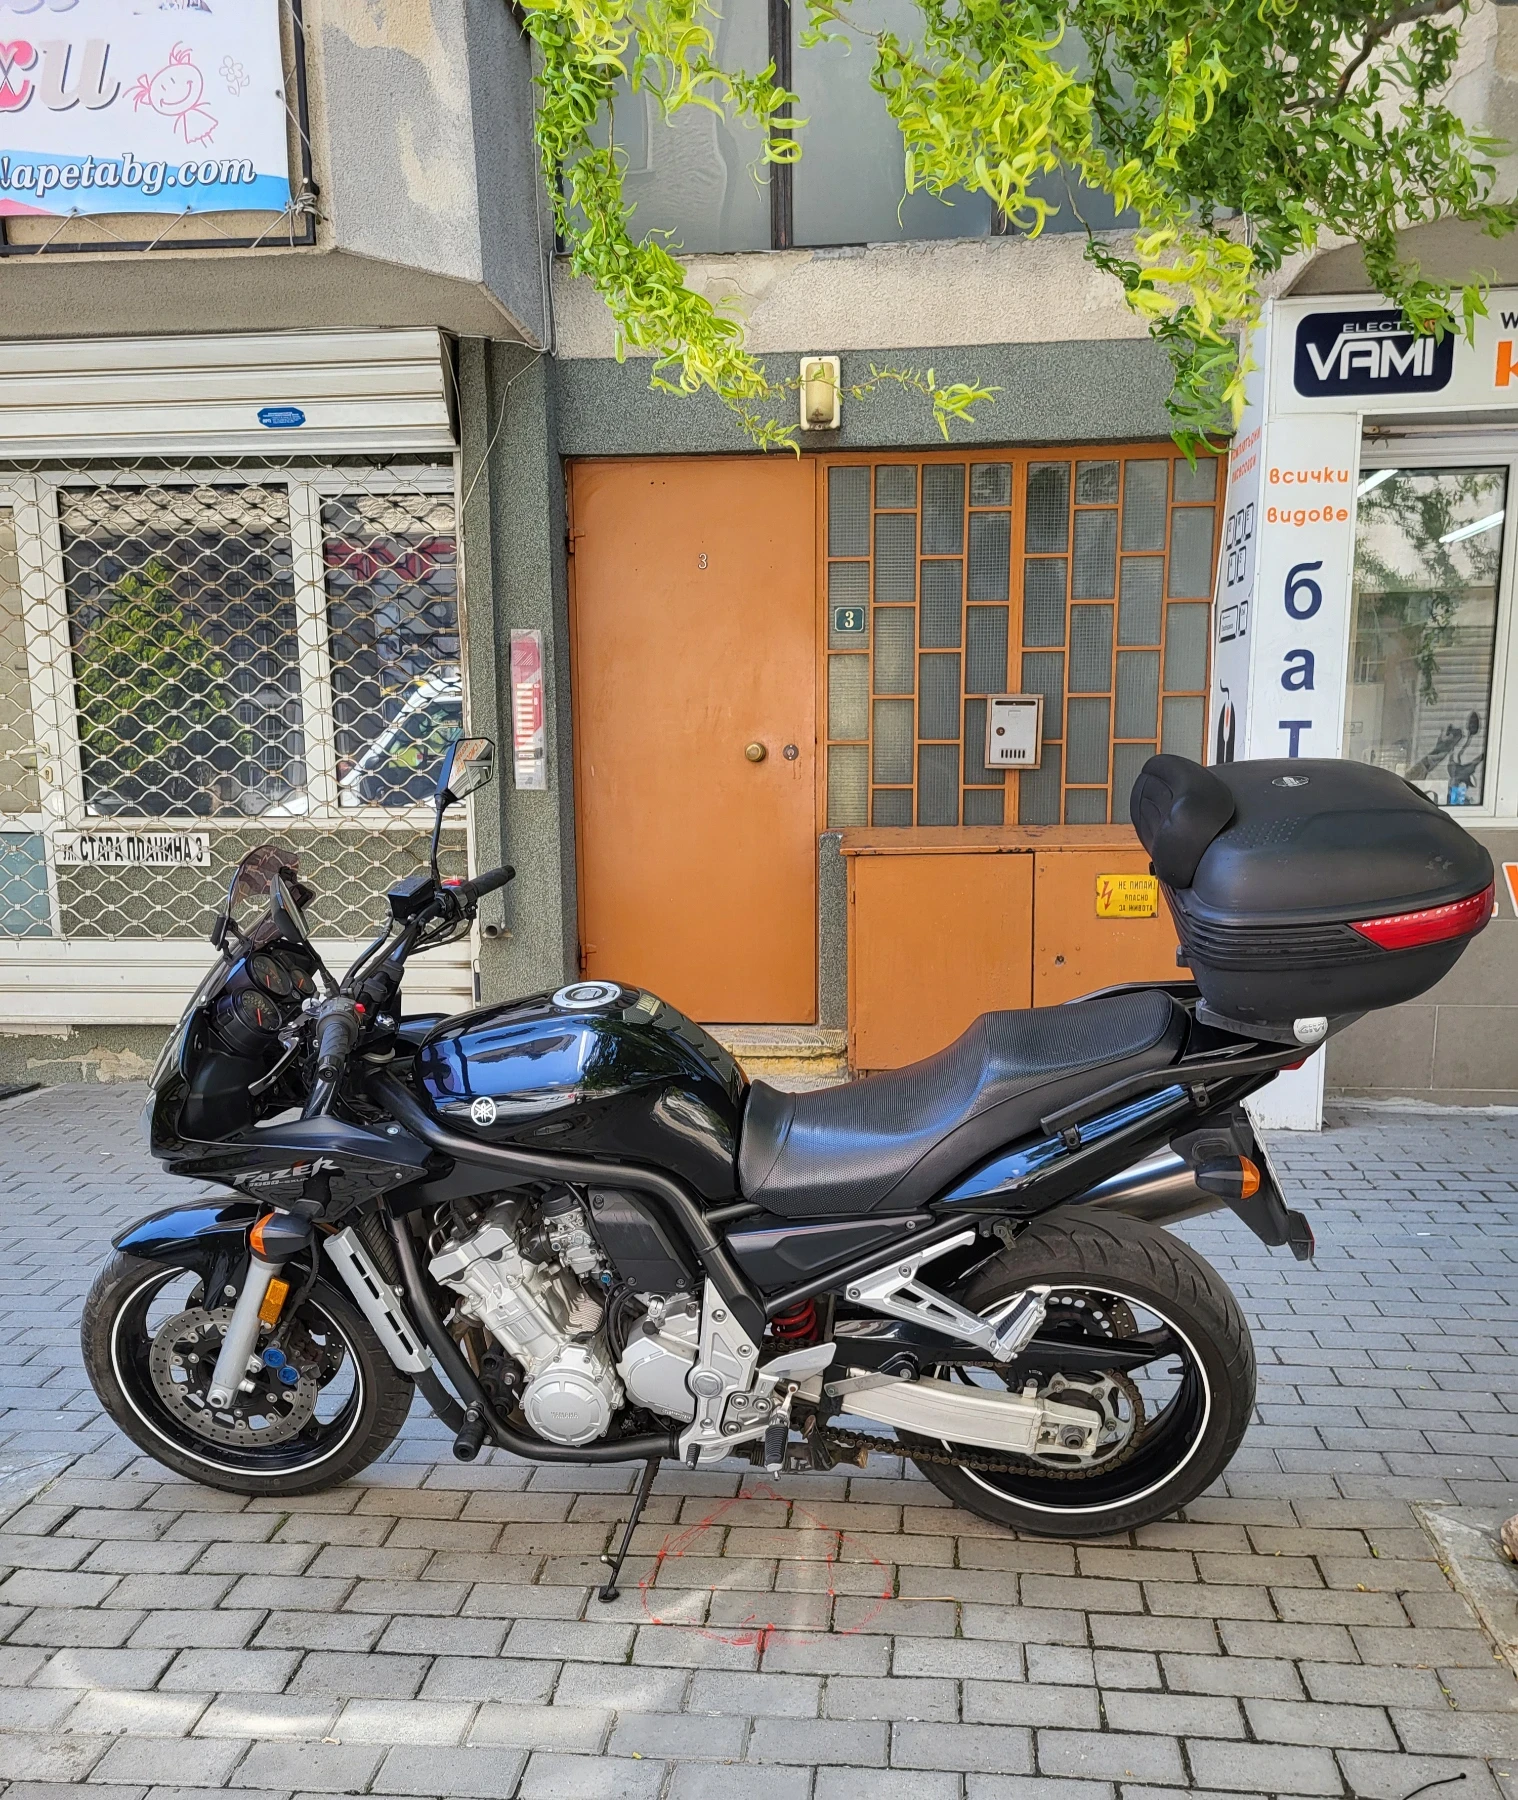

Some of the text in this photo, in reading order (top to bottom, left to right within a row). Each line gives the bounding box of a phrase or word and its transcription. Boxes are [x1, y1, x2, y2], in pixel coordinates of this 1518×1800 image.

[1305, 332, 1435, 381] VAMI
[1269, 466, 1349, 485] всички
[1267, 505, 1349, 528] видове
[698, 553, 708, 570] 3
[844, 610, 855, 628] 3
[79, 835, 124, 862] СТАРА
[126, 836, 193, 863] ПЛАНИНА
[1118, 880, 1127, 890] НЕ
[1361, 897, 1480, 928] MONOKEY SYSTEM
[232, 1156, 340, 1186] FAZER
